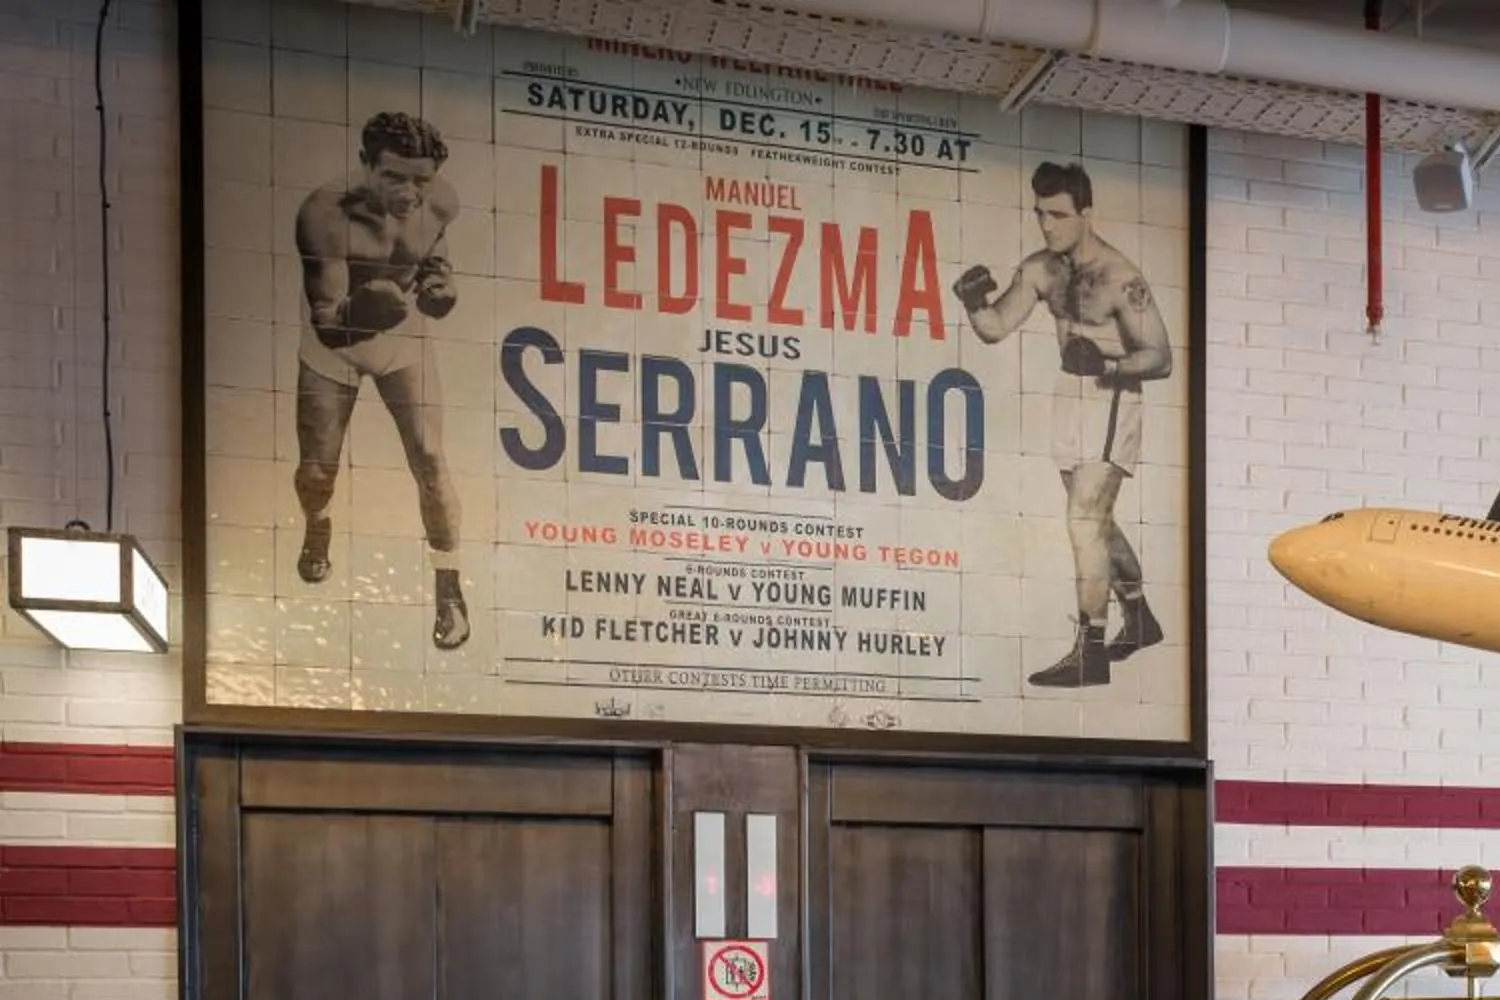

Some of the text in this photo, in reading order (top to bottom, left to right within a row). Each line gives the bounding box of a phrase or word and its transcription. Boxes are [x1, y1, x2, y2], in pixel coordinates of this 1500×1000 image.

[527, 82, 695, 131] SATURDAY,
[719, 108, 785, 139] DEC.
[866, 128, 925, 157] 7.30
[937, 137, 971, 161] AT
[575, 125, 615, 141] EXTRA
[620, 132, 669, 147] SPECIAL
[751, 149, 846, 169] FEATHERWEIGHT
[849, 160, 900, 176] CONTEST
[705, 175, 802, 211] MANUEL
[539, 164, 945, 341] LEDEZMA
[697, 329, 802, 361] JESUS
[499, 325, 985, 502] SERRANO
[524, 520, 618, 545] YOUNG
[629, 528, 750, 552] MOSELEY
[781, 538, 867, 561] YOUNG
[878, 545, 960, 568] TEGON
[629, 509, 865, 539] SPECIAL 10-ROUNDS CONTEST
[565, 569, 646, 595] LENNY
[657, 575, 718, 600] NEAL
[752, 581, 832, 606] YOUNG
[841, 585, 926, 612] MUFFIN
[751, 569, 805, 580] CONTEST
[541, 615, 585, 639] KID
[595, 618, 719, 646] FLETCHER
[753, 627, 849, 651] JOHNNY
[857, 631, 947, 657] HURLEY
[669, 609, 707, 622] GREAT
[777, 615, 830, 628] CONTEST
[609, 669, 886, 693] OTHER CONTESTS TIME PERMITTING
